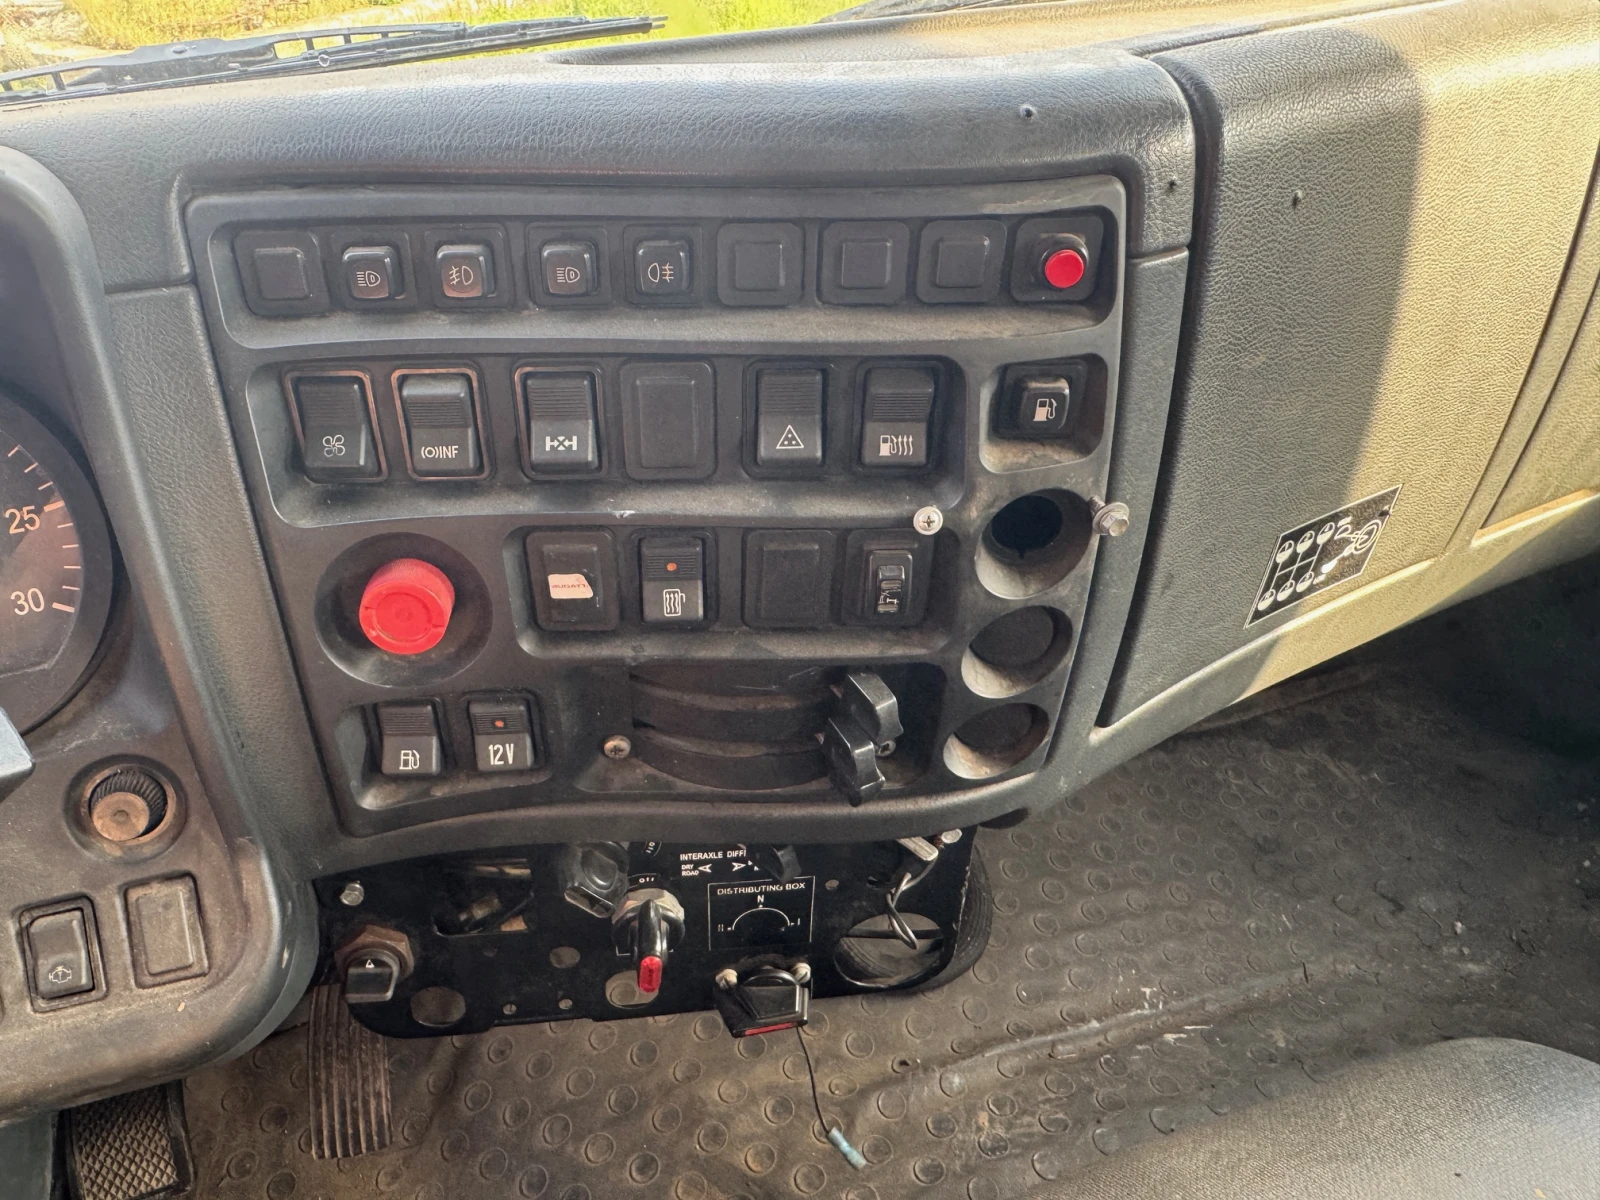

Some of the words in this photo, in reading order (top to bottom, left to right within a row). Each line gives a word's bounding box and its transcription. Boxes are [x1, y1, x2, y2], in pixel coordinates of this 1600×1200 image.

[5, 505, 41, 534] 25
[10, 587, 45, 615] 30
[488, 743, 514, 765] 12V
[679, 850, 723, 861] INTERAXLE
[726, 849, 747, 858] DIFF
[681, 863, 694, 871] DRY
[717, 884, 783, 895] DISTRIBUTING
[785, 882, 806, 891] BOX
[757, 894, 765, 904] N
